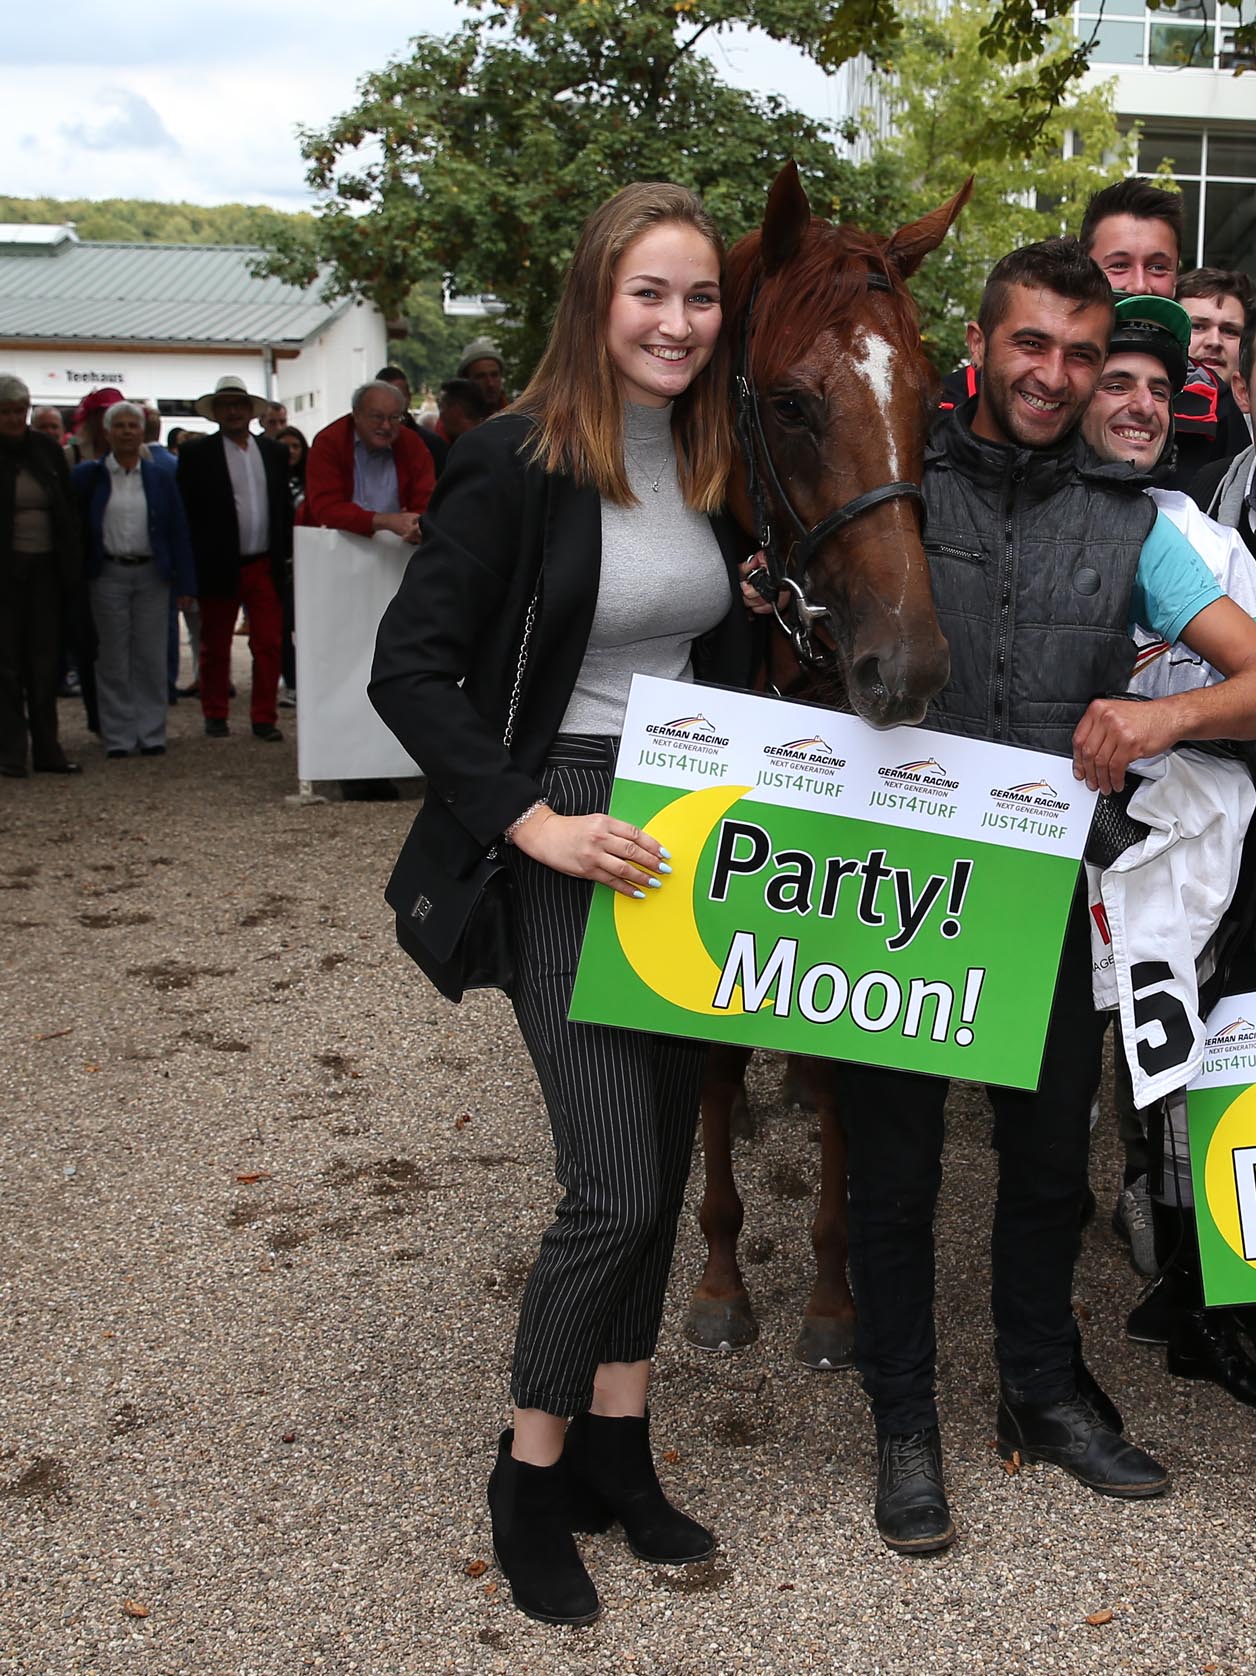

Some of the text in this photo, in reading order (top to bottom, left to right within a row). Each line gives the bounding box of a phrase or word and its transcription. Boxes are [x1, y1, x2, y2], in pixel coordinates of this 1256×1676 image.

[66, 371, 124, 383] Teehaus
[646, 724, 730, 746] GERMAN RACING
[652, 738, 719, 755] NEXT GENERATION
[637, 749, 729, 778] JUST4TURF
[763, 745, 847, 768] GERMAN RACING
[770, 759, 835, 776] NEXT GENERATION
[755, 770, 845, 798] JUST4TURF
[877, 767, 960, 789] GERMAN RACING
[883, 780, 949, 798] NEXT GENERATION
[868, 791, 958, 819] JUST4TURF
[990, 788, 1070, 811] GERMAN RACING
[995, 802, 1059, 819] NEXT GENERATION
[980, 812, 1068, 840] JUST4TURF
[708, 820, 973, 951] Party!
[712, 930, 987, 1048] Moon!
[1130, 961, 1195, 1077] 5
[1209, 1046, 1224, 1054] NEXT
